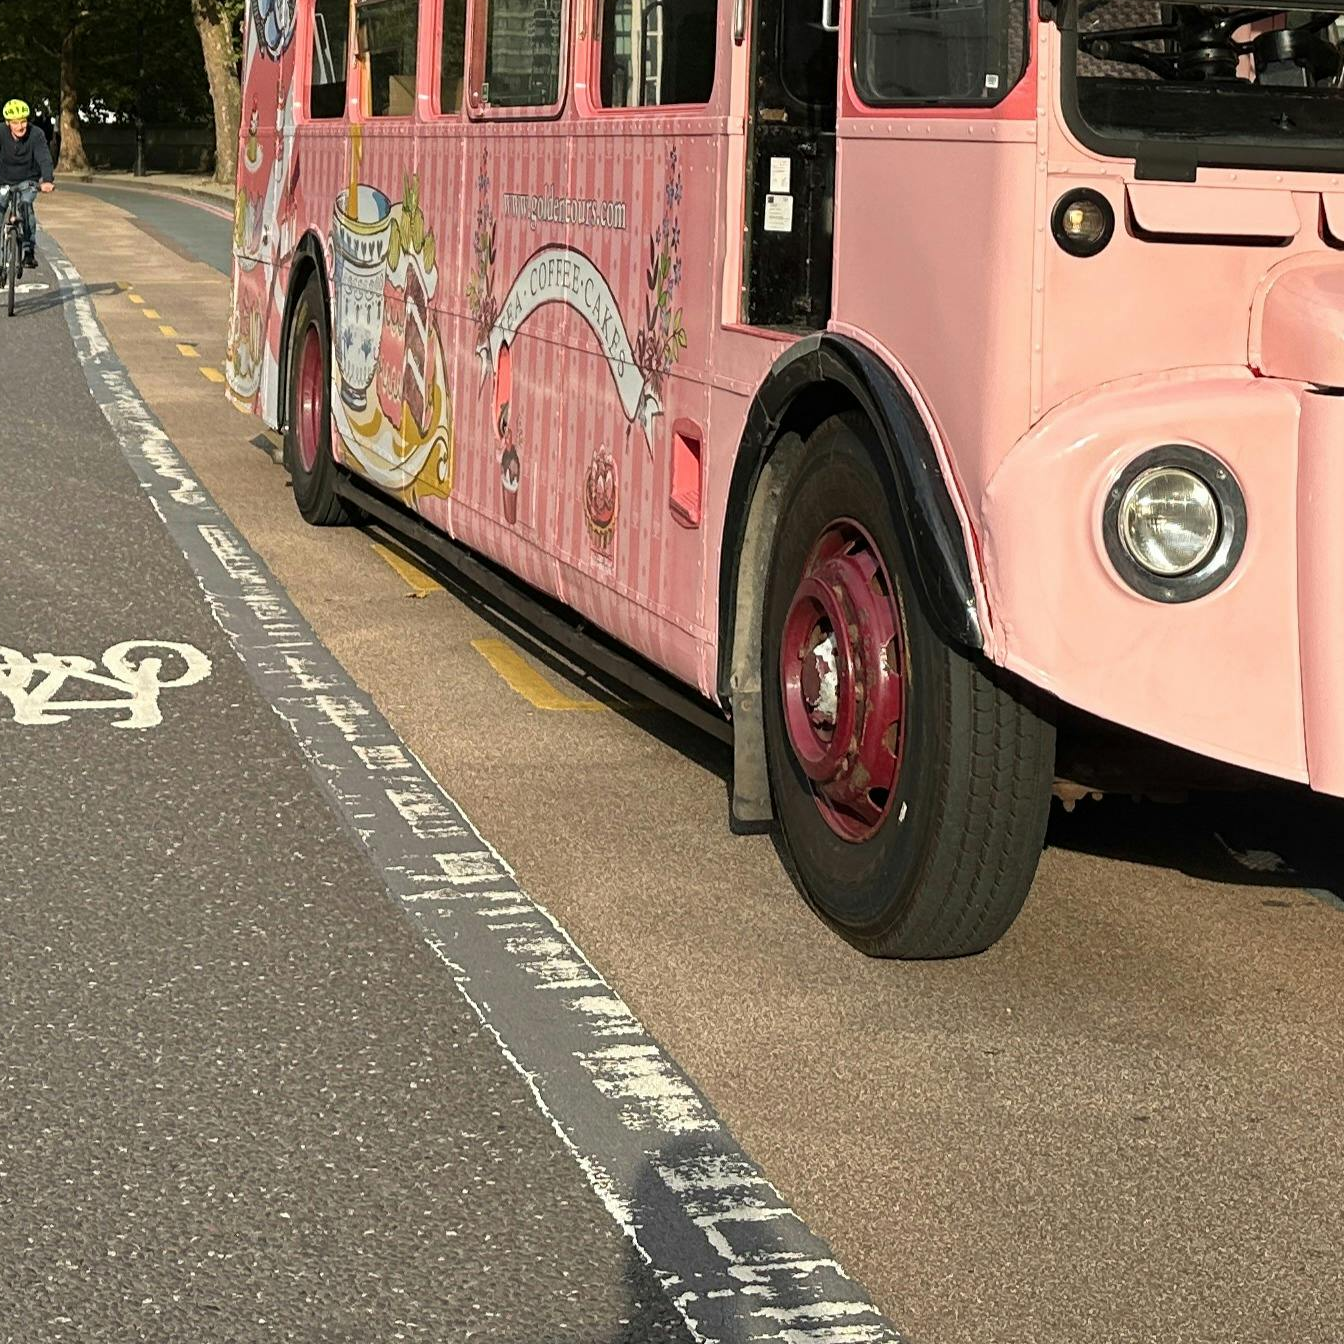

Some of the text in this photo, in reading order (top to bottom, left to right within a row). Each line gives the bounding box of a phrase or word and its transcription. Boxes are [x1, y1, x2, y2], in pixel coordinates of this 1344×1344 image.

[503, 182, 627, 231] www.goldentours.com
[498, 258, 626, 378] TEA COFFEE CAKES
